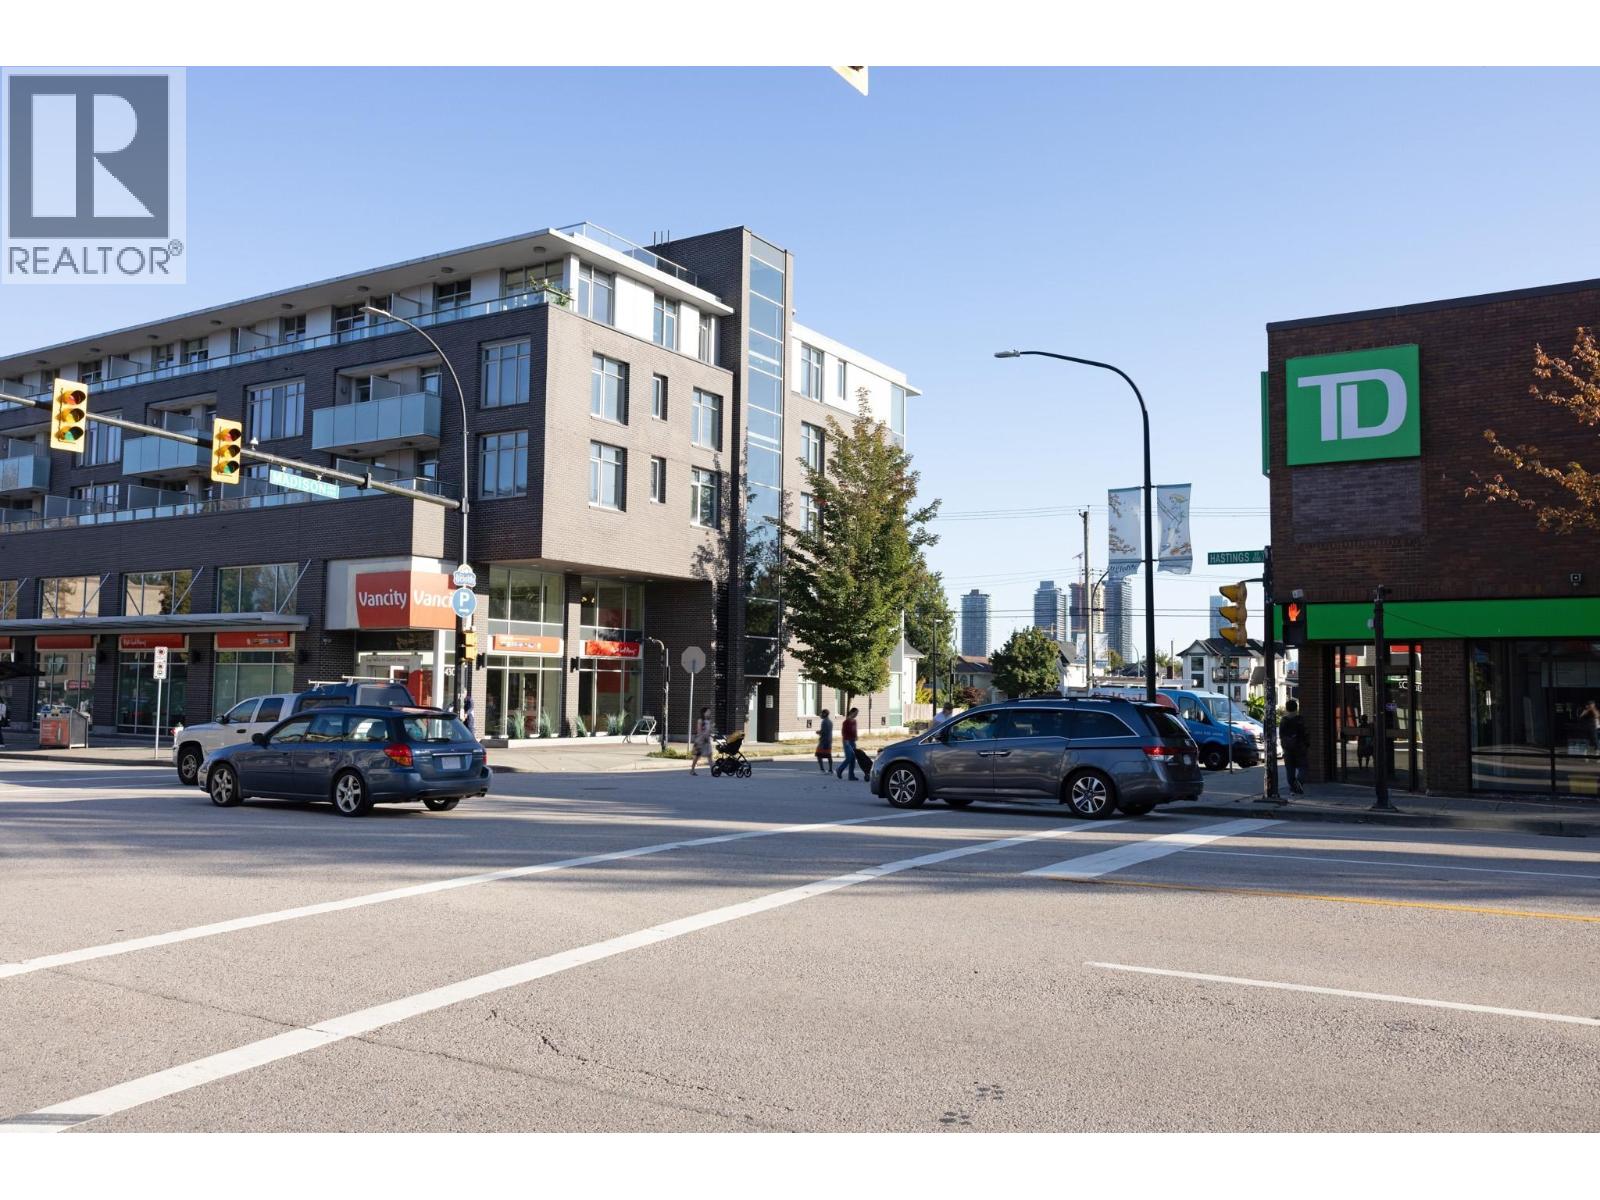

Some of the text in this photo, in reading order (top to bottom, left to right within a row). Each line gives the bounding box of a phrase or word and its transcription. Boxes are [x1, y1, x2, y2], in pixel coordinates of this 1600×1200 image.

[1297, 368, 1407, 442] TD
[272, 471, 326, 494] MADISON
[1210, 552, 1250, 563] HASTINGS
[358, 588, 407, 609] Vancity
[413, 588, 453, 608] Vanci
[460, 592, 470, 607] P
